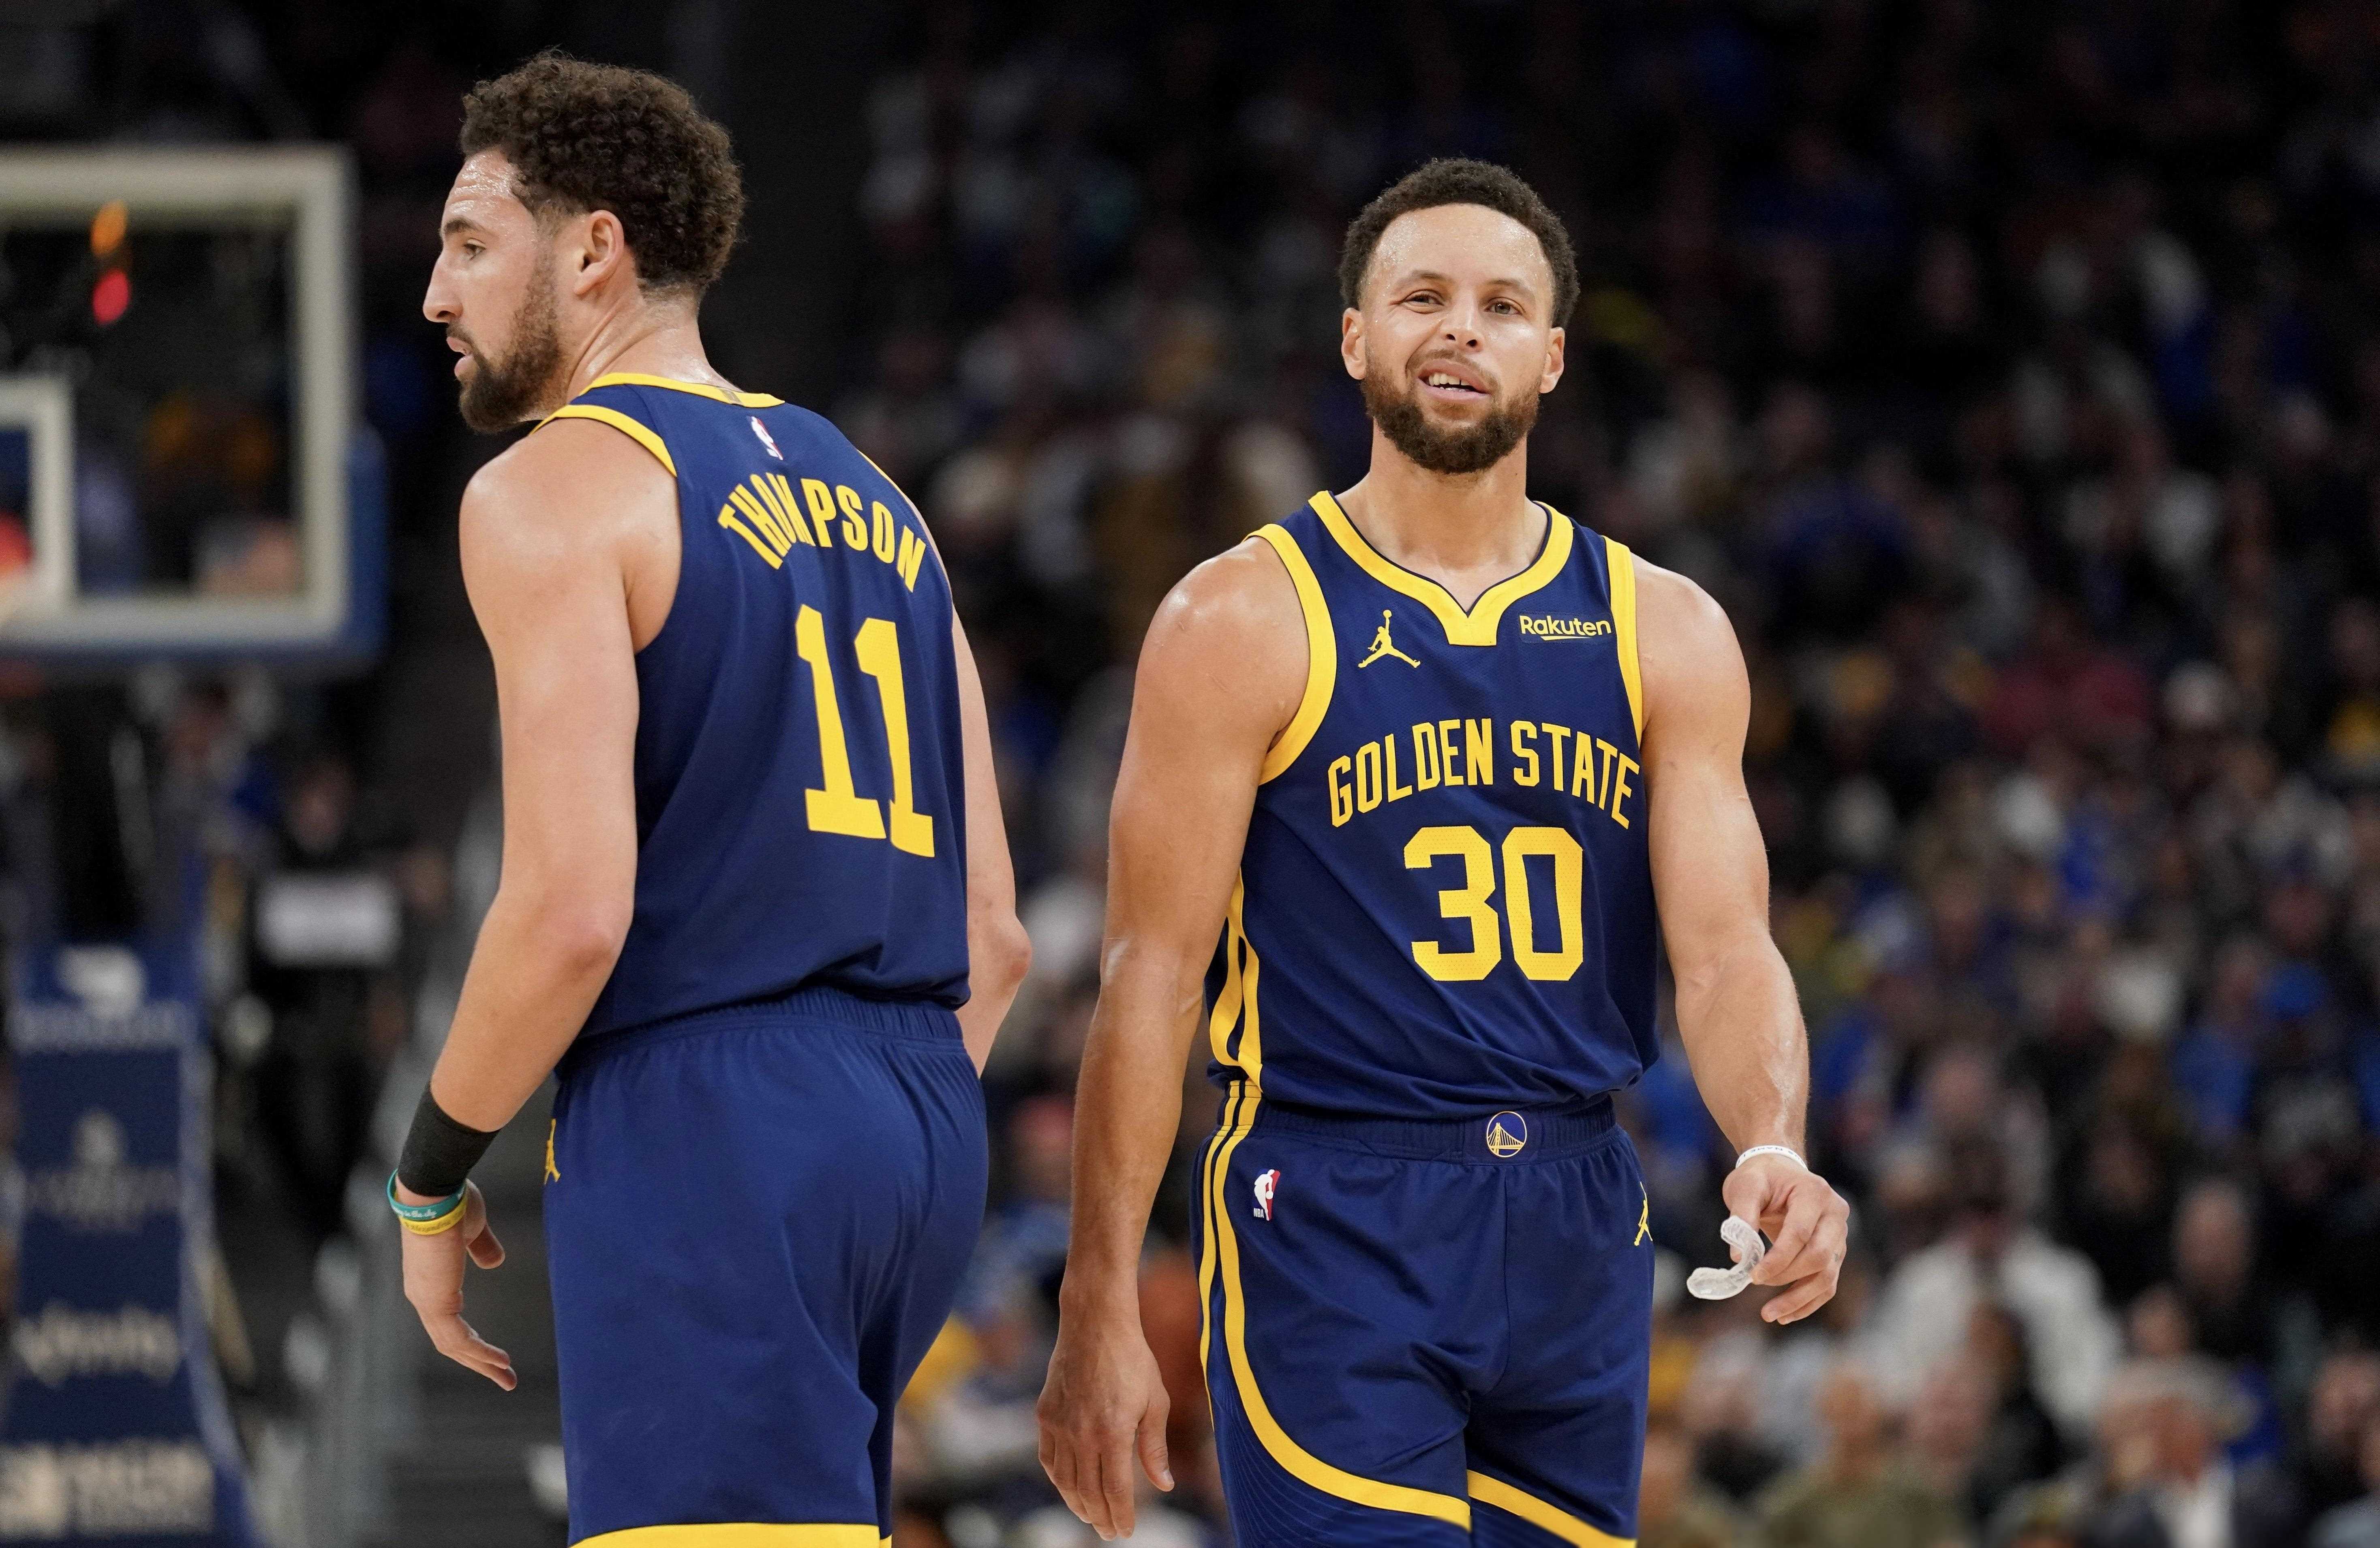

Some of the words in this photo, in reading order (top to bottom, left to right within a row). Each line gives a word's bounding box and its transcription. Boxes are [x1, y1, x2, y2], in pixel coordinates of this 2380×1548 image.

[718, 474, 926, 592] THOMPSON
[1520, 615, 1612, 636] Rakuten
[795, 604, 935, 858] 11
[1327, 718, 1493, 828] GOLDEN
[1510, 720, 1640, 829] STATE
[1404, 825, 1583, 981] 30
[1254, 1208, 1264, 1218] NBA
